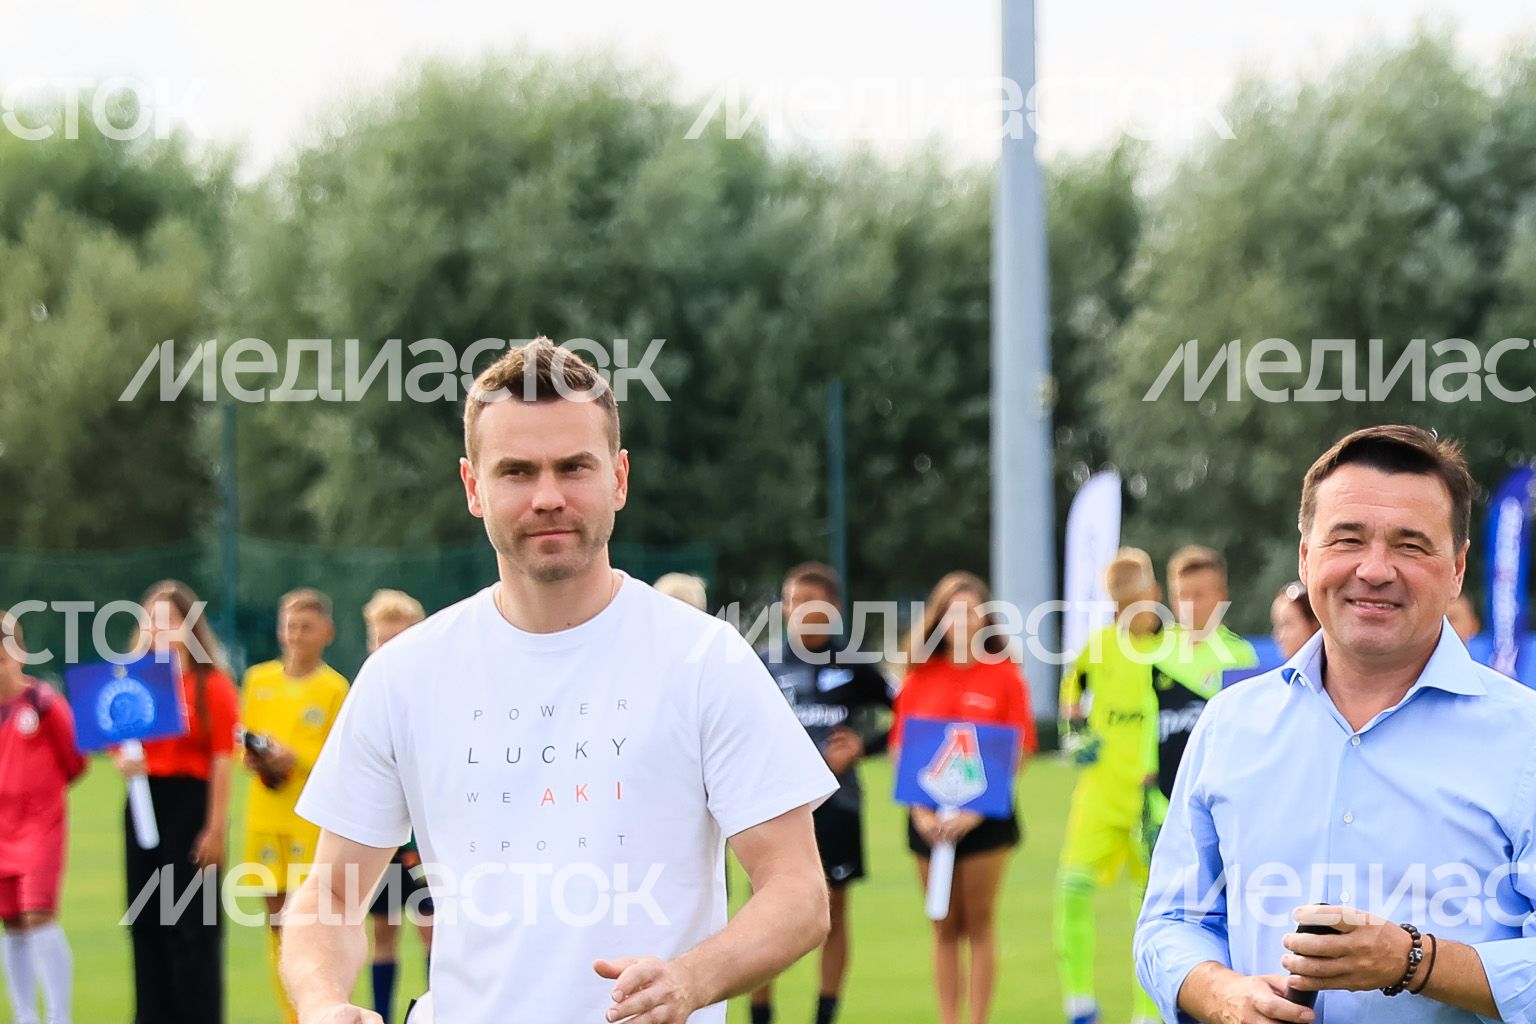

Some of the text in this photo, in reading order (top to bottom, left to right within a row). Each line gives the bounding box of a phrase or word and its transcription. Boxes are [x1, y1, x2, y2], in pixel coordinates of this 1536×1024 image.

[473, 698, 628, 721] POWER
[467, 737, 626, 764] LUCKY
[540, 781, 622, 806] AKI
[470, 835, 625, 852] SPORT
